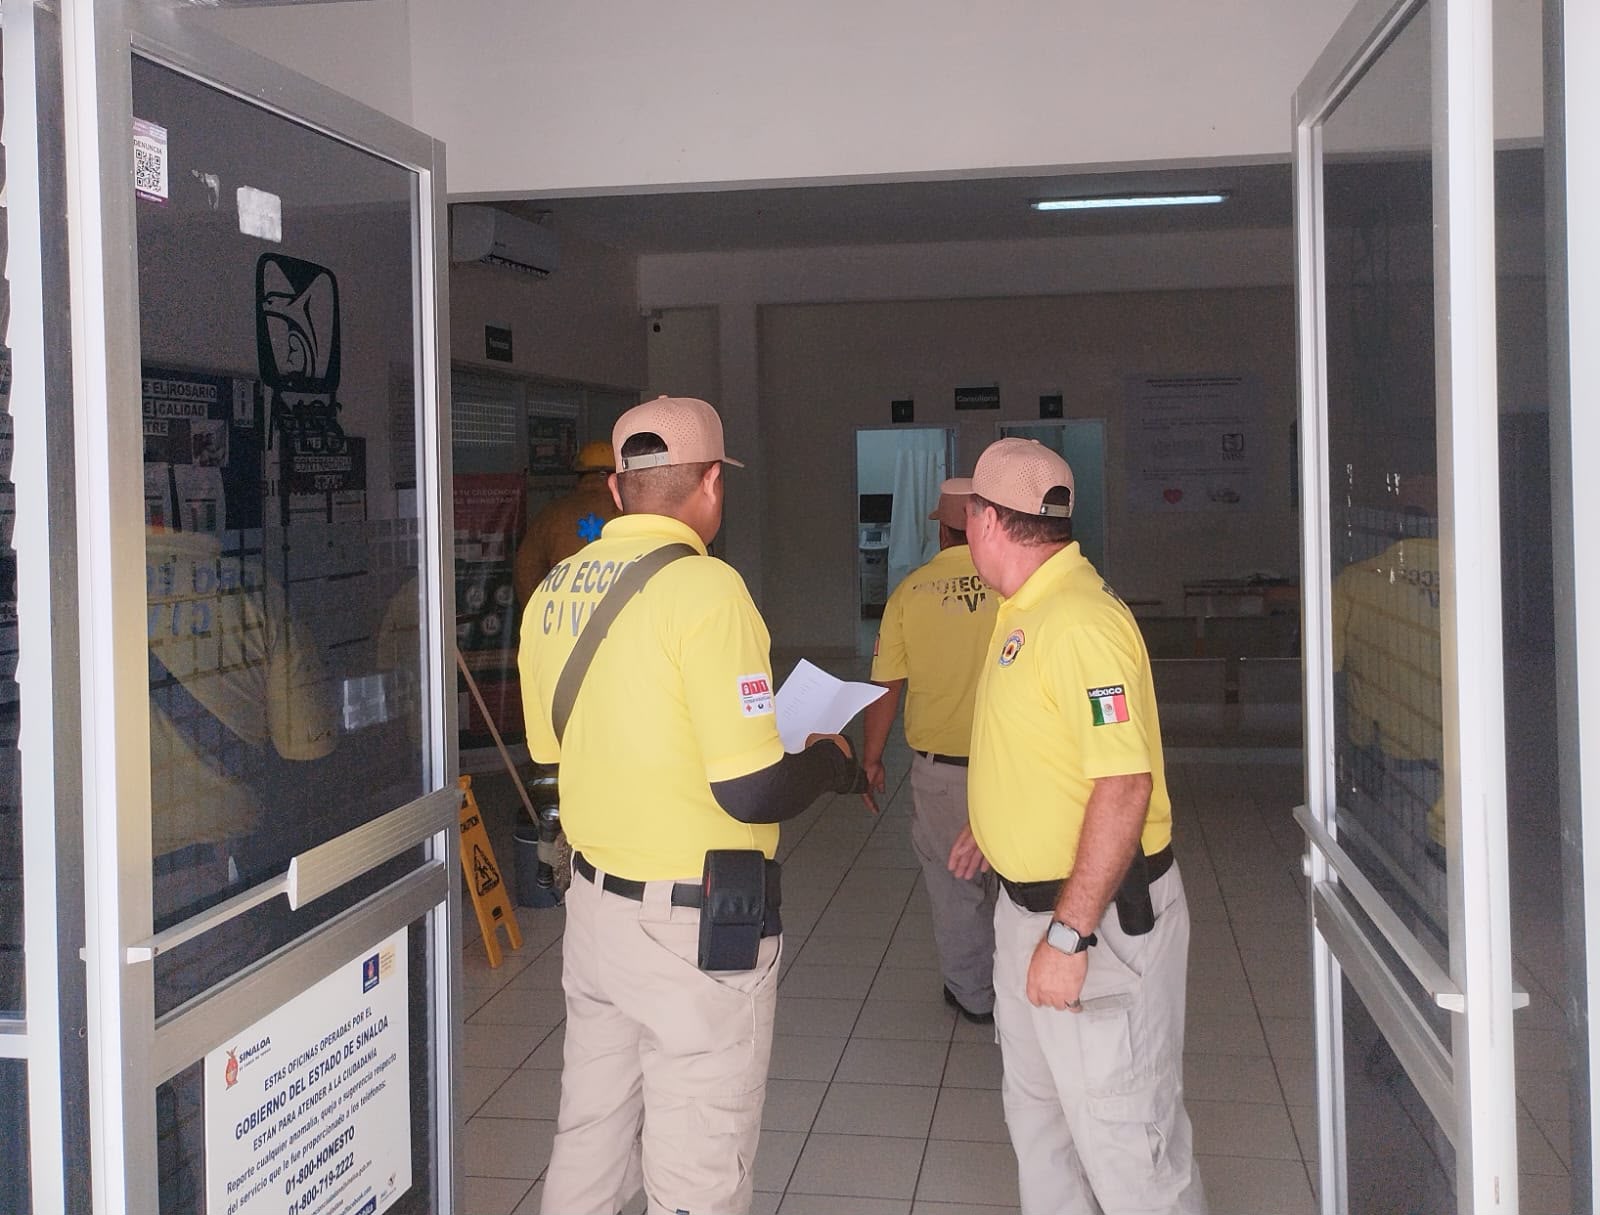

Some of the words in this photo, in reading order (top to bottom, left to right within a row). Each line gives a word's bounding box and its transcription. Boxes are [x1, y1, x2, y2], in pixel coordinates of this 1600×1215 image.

[133, 139, 163, 155] DENUNCIA
[158, 403, 206, 417] CALIDAD
[169, 384, 216, 399] ROSARIO
[742, 680, 769, 696] 911
[235, 1090, 287, 1140] GOBIERNO
[289, 1077, 306, 1101] DEL
[308, 1050, 342, 1087] ESTADO
[343, 1039, 354, 1060] DE
[356, 1015, 389, 1050] SINALOA
[239, 1036, 271, 1064] SINALOA
[264, 1066, 287, 1092] ESTAS
[287, 1044, 319, 1075] OFICINAS
[319, 1020, 351, 1051] OPERADAS
[352, 1011, 365, 1029] POR
[365, 1006, 373, 1019] EL
[227, 1166, 255, 1195] Reporte
[256, 1139, 288, 1171] cualquier
[343, 1070, 373, 1101] sugerencia
[278, 1110, 296, 1132] PARA
[297, 1086, 327, 1118] ATENDER
[333, 1074, 342, 1089] LA
[227, 1198, 239, 1215] del
[239, 1176, 268, 1207] servicio
[268, 1166, 282, 1183] que
[302, 1112, 345, 1159] proporcionado
[350, 1101, 360, 1116] los
[285, 1125, 355, 1196] 01-800-HONESTO
[288, 1152, 354, 1215] 01-800-719-2222
